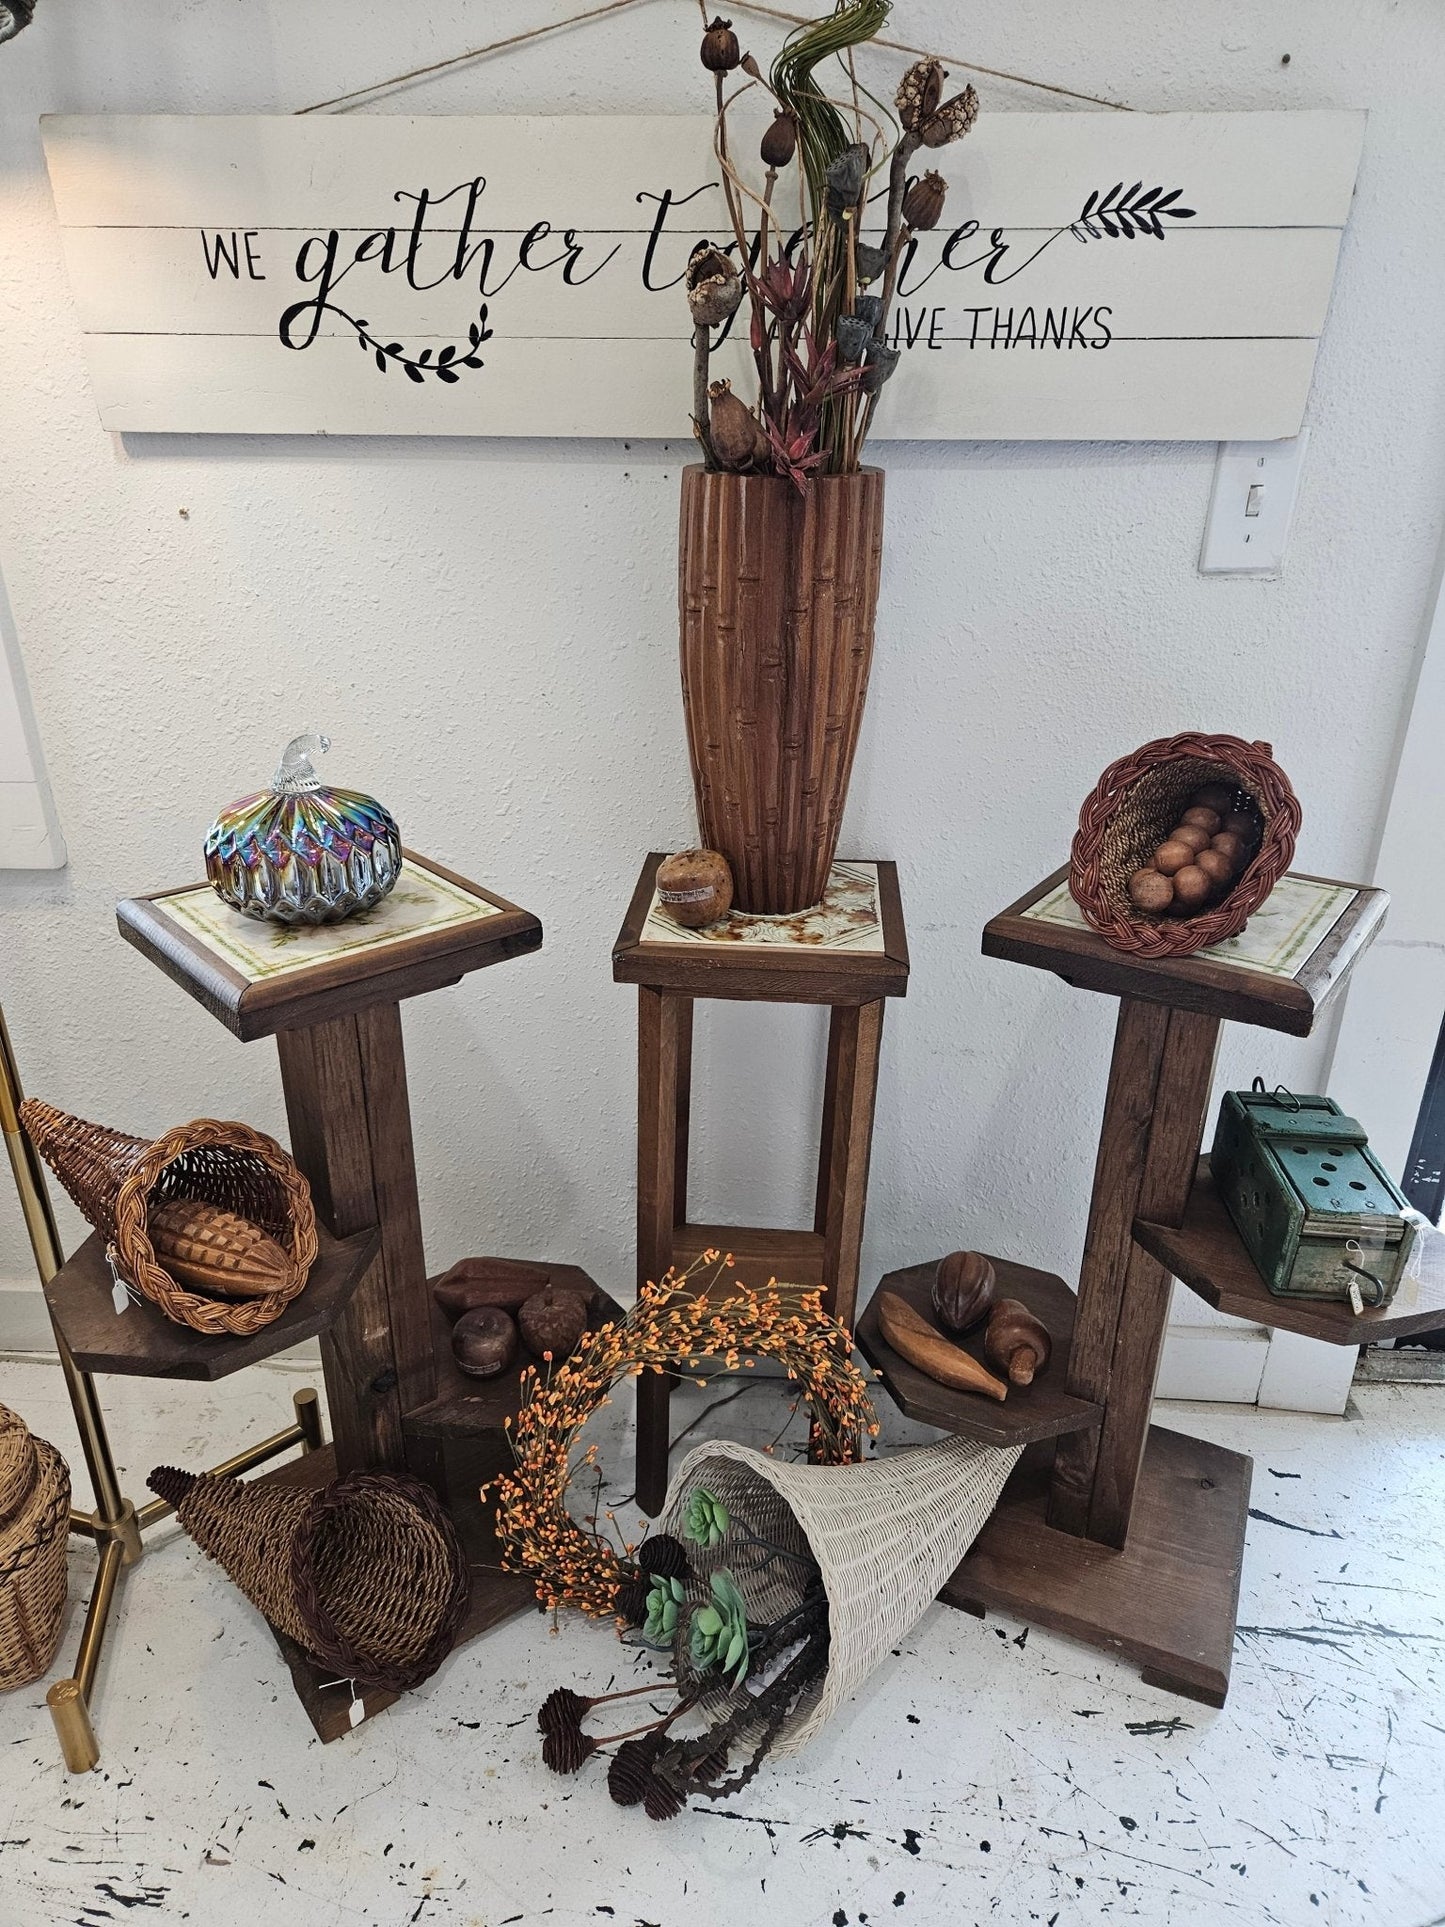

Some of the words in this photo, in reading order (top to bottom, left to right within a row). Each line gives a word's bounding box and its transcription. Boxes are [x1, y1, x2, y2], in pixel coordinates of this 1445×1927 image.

[200, 231, 266, 280] WE
[279, 176, 621, 350] gather
[884, 306, 945, 351] IVE
[963, 306, 1112, 351] THANKS
